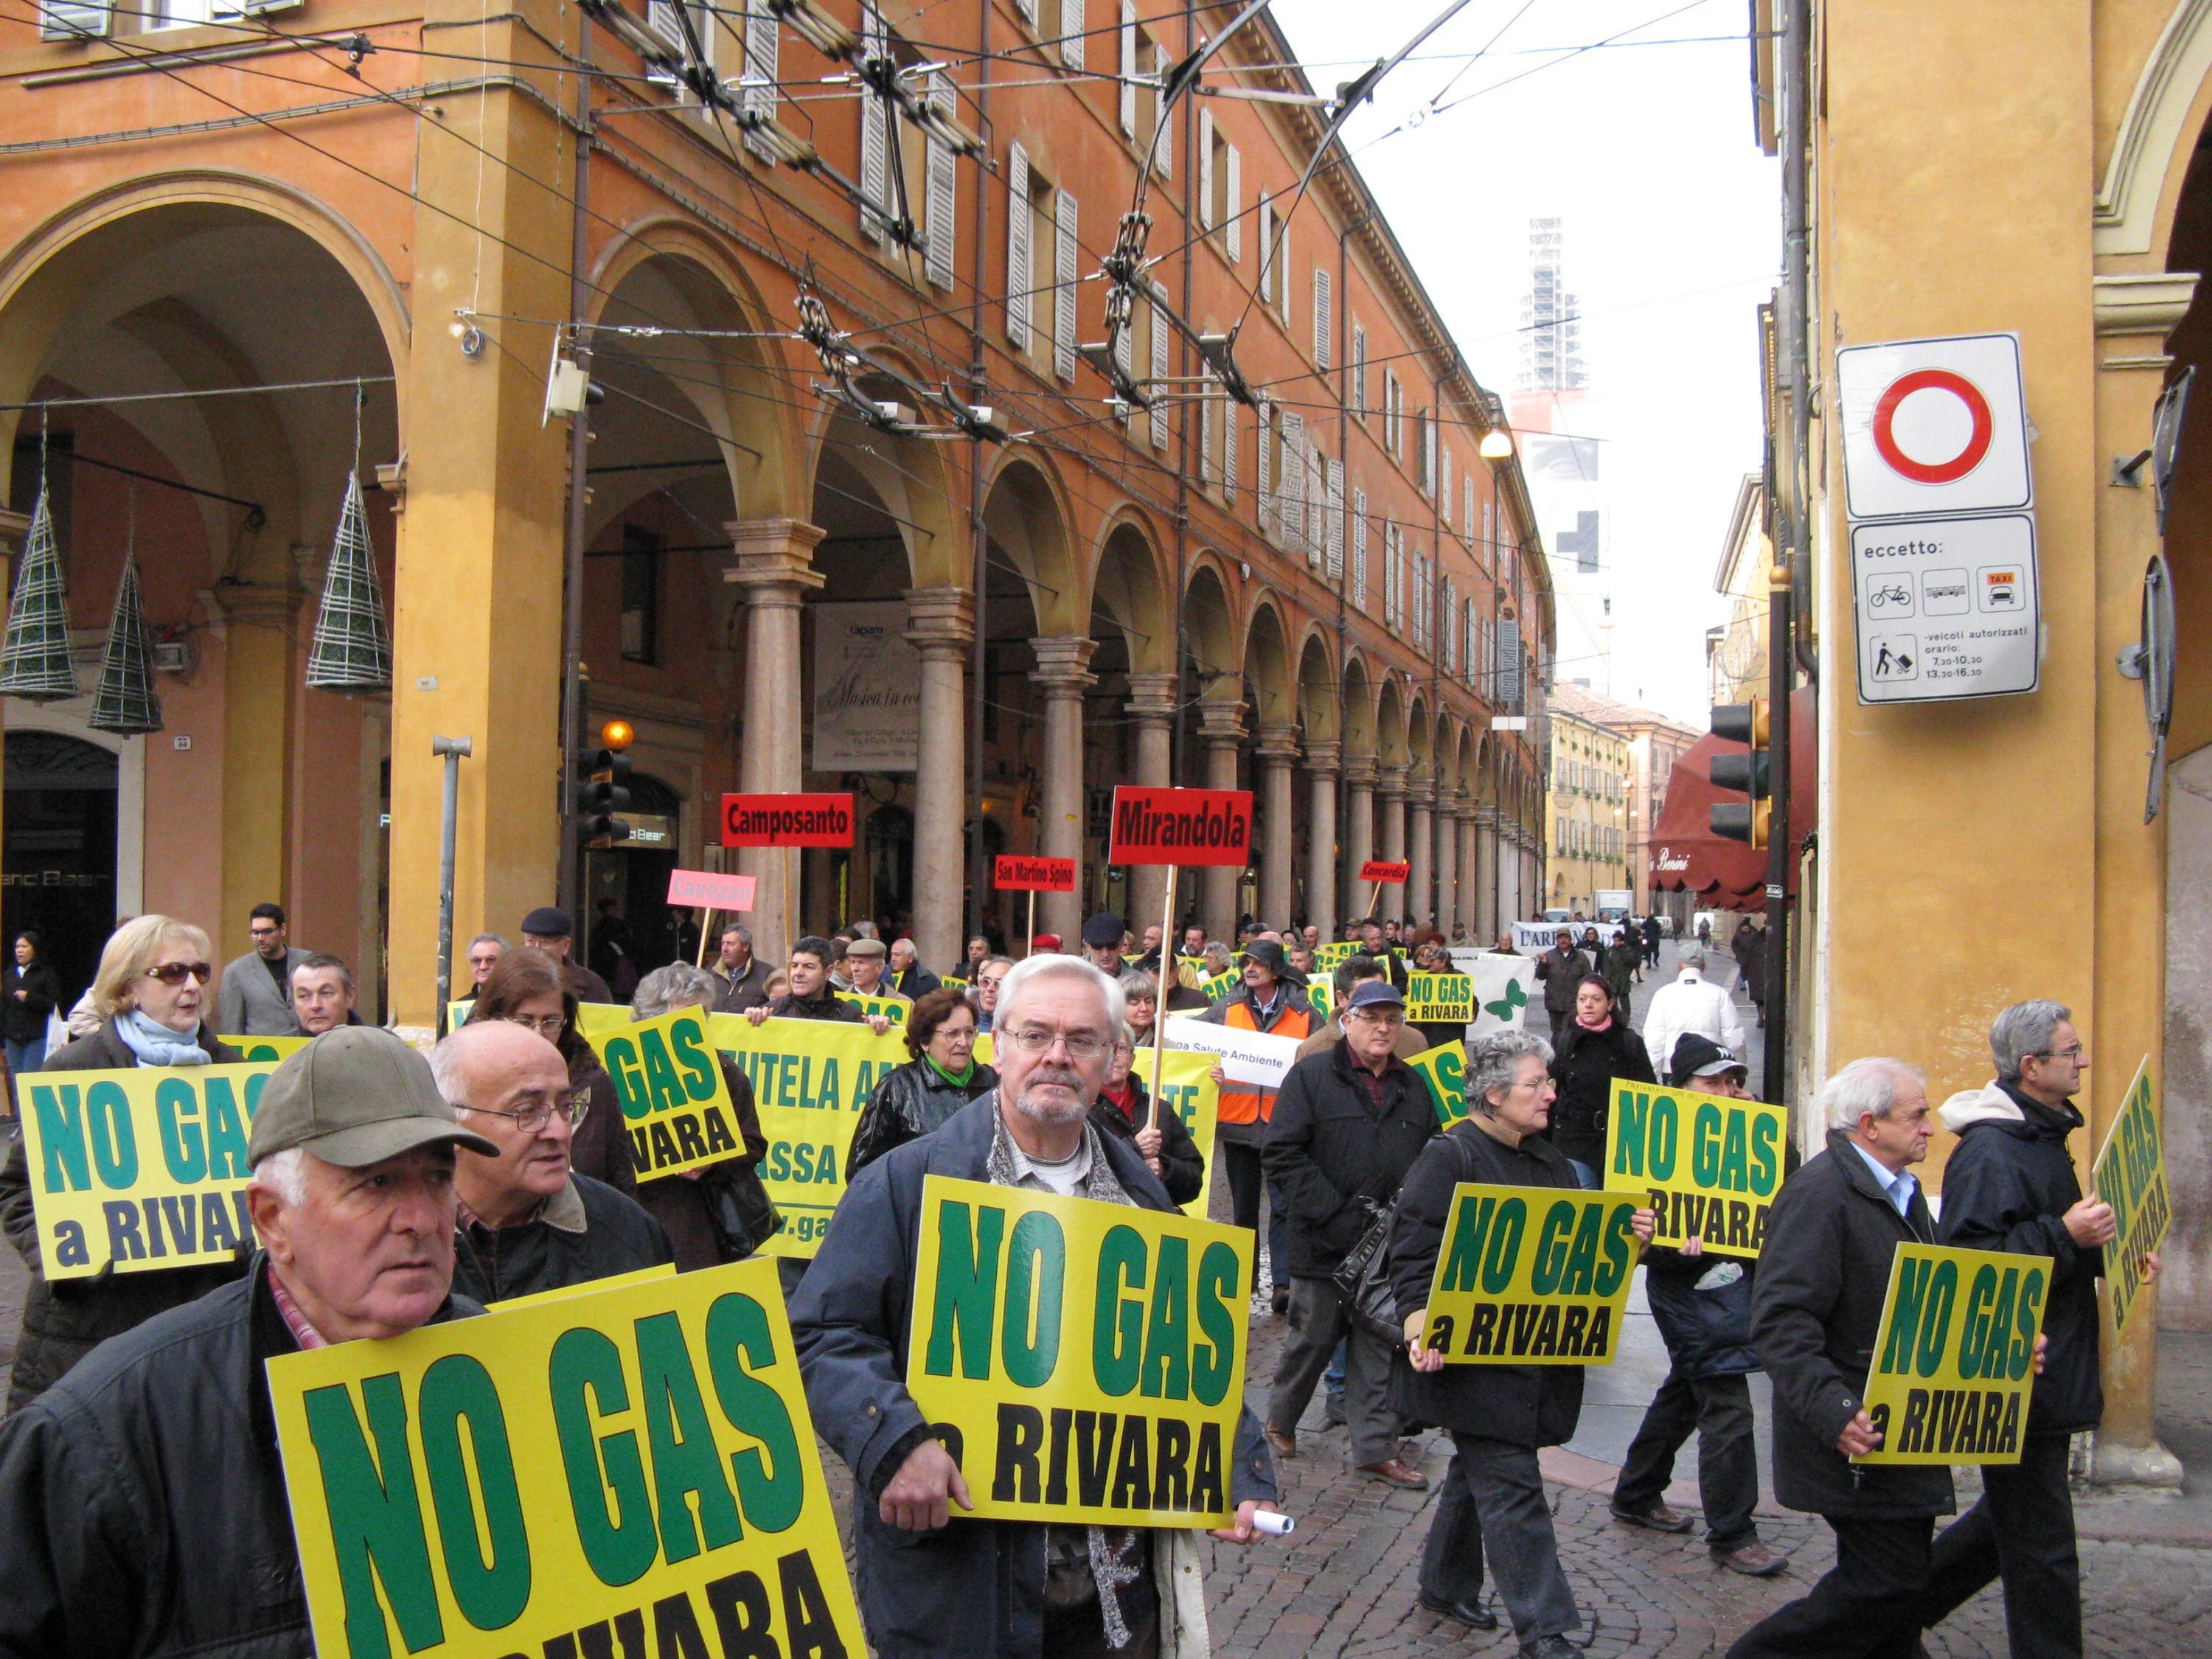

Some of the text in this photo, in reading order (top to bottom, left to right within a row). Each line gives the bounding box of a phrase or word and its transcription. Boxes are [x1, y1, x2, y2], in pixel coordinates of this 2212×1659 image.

[1864, 540, 1944, 559] eccetto:
[1991, 575, 2012, 583] TAXI
[1969, 627, 2028, 639] autorizzati
[637, 827, 666, 841] Bear
[728, 803, 848, 843] Camposanto
[1116, 798, 1245, 848] Mirandola
[672, 875, 752, 902] Cavezzo
[998, 861, 1072, 887] San Martino Spino
[1363, 863, 1406, 878] Concordia
[1409, 1005, 1469, 1020] a RIVARA
[1410, 976, 1471, 1004] NO GAS
[604, 1018, 717, 1120] GAS
[720, 1049, 840, 1111] UTELA
[1229, 1050, 1284, 1068] Ambiente
[30, 1081, 139, 1194] NO
[1613, 1089, 1778, 1197] NO GAS
[2122, 1075, 2158, 1211] GAS
[53, 1220, 90, 1267] a
[1646, 1188, 1770, 1251] RIVARA
[1441, 1195, 1638, 1298] NO GAS
[925, 1199, 1240, 1407] NO GAS
[1879, 1256, 2044, 1382] NO GAS
[1427, 1303, 1611, 1357] a RIVARA
[1897, 1388, 2020, 1454] RIVARA
[303, 1292, 804, 1659] NO GAS
[991, 1402, 1224, 1514] RIVARA
